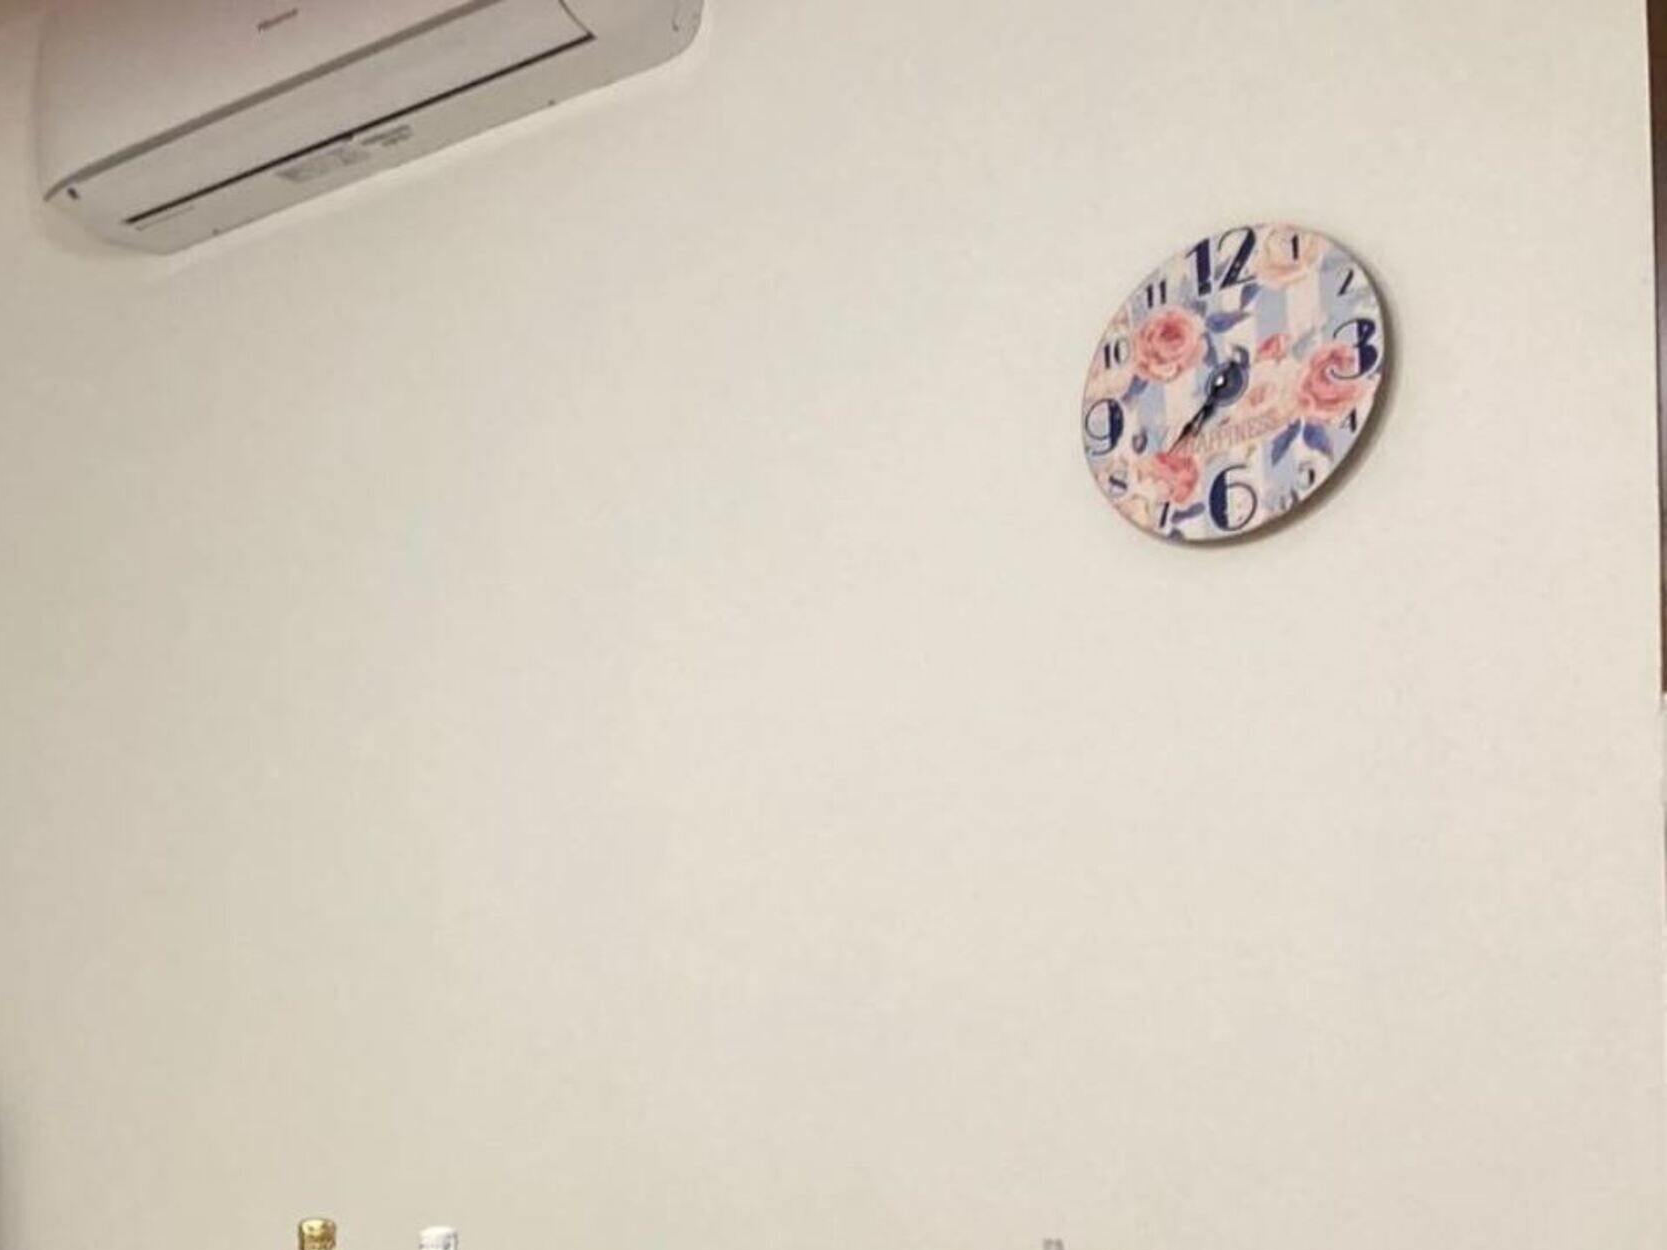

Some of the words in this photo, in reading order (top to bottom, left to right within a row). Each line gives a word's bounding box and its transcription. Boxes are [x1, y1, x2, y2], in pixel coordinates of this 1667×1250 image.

[1185, 225, 1257, 297] 12
[1291, 234, 1299, 261] 1
[1146, 278, 1167, 309] 11
[1103, 336, 1130, 369] 10
[1330, 317, 1379, 380] 3
[1085, 398, 1124, 457] 9
[1339, 407, 1357, 434] 4
[1108, 469, 1128, 498] 8
[1209, 465, 1258, 532] 6
